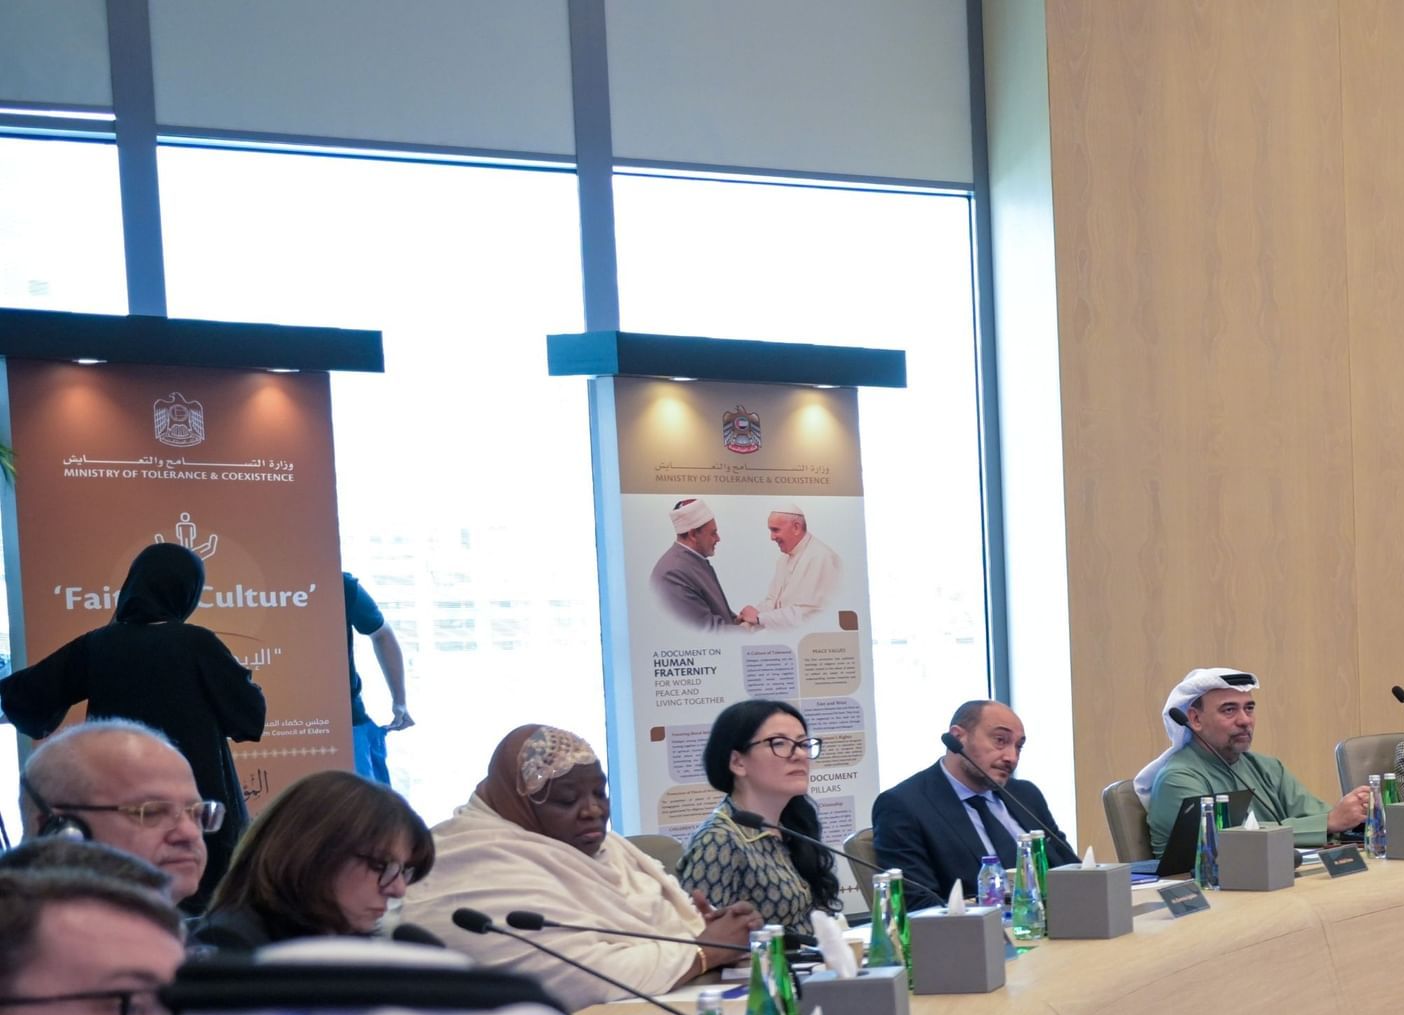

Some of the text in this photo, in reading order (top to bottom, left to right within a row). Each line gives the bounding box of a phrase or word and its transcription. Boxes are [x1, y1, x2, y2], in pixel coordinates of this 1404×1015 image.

[269, 458, 294, 471] وزارة
[63, 468, 294, 482] MINISTRY OF TOLERANCE & COEXISTENCE
[655, 474, 697, 482] MINISTRY
[713, 475, 765, 484] TOLERANCE
[774, 476, 830, 485] COEXISTENCE
[53, 584, 121, 610] ‘Fait
[660, 649, 707, 658] DOCUMENT
[708, 648, 721, 656] ON
[653, 658, 695, 668] HUMAN
[654, 667, 717, 677] FRATERNITY
[655, 688, 700, 697] PEACE AND
[656, 697, 725, 707] LIVING TOGETHER
[810, 772, 858, 783] DOCUMENT
[811, 784, 842, 794] PILLARS
